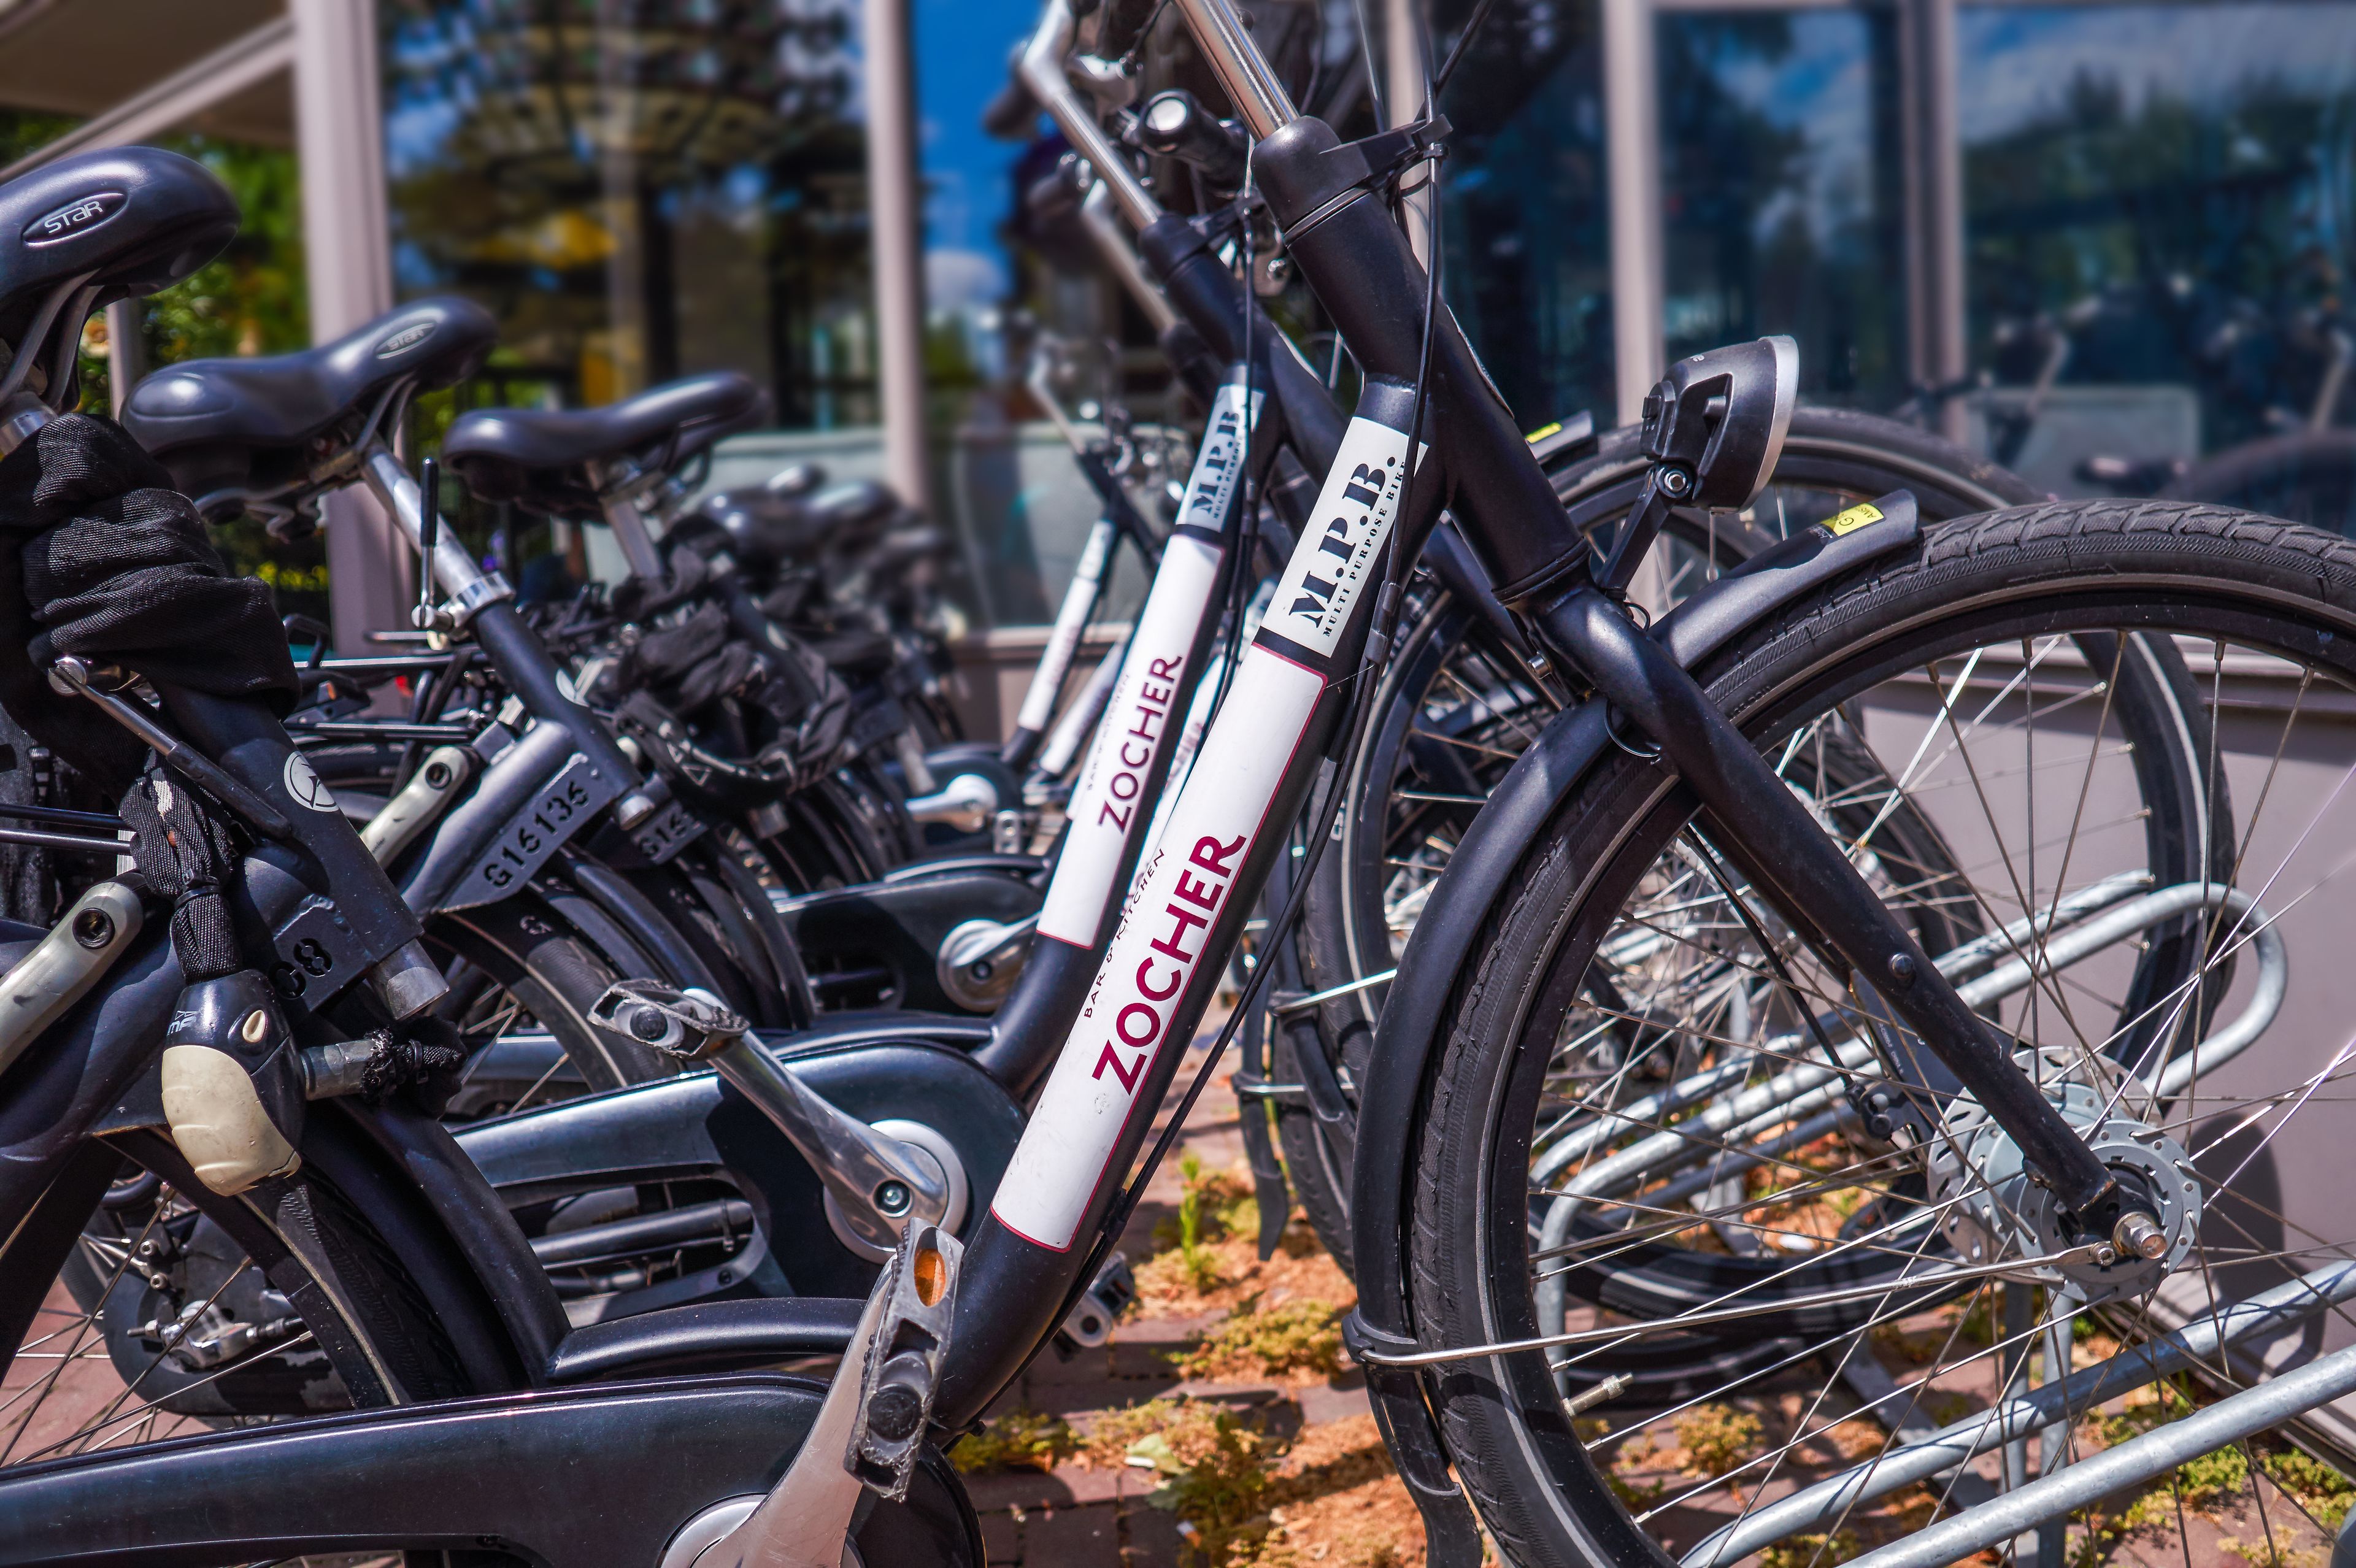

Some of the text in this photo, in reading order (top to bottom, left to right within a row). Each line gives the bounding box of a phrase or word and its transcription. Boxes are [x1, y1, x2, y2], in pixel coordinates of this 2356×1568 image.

[1288, 456, 1396, 628] M.P.B.
[1323, 588, 1350, 637] MULTI
[1349, 508, 1387, 580] PURPOSE
[1098, 656, 1182, 835] ZOCHER
[483, 780, 589, 889] G16136
[1084, 848, 1165, 1018] BAR & KITCHEN
[1091, 835, 1247, 1096] ZOCHER
